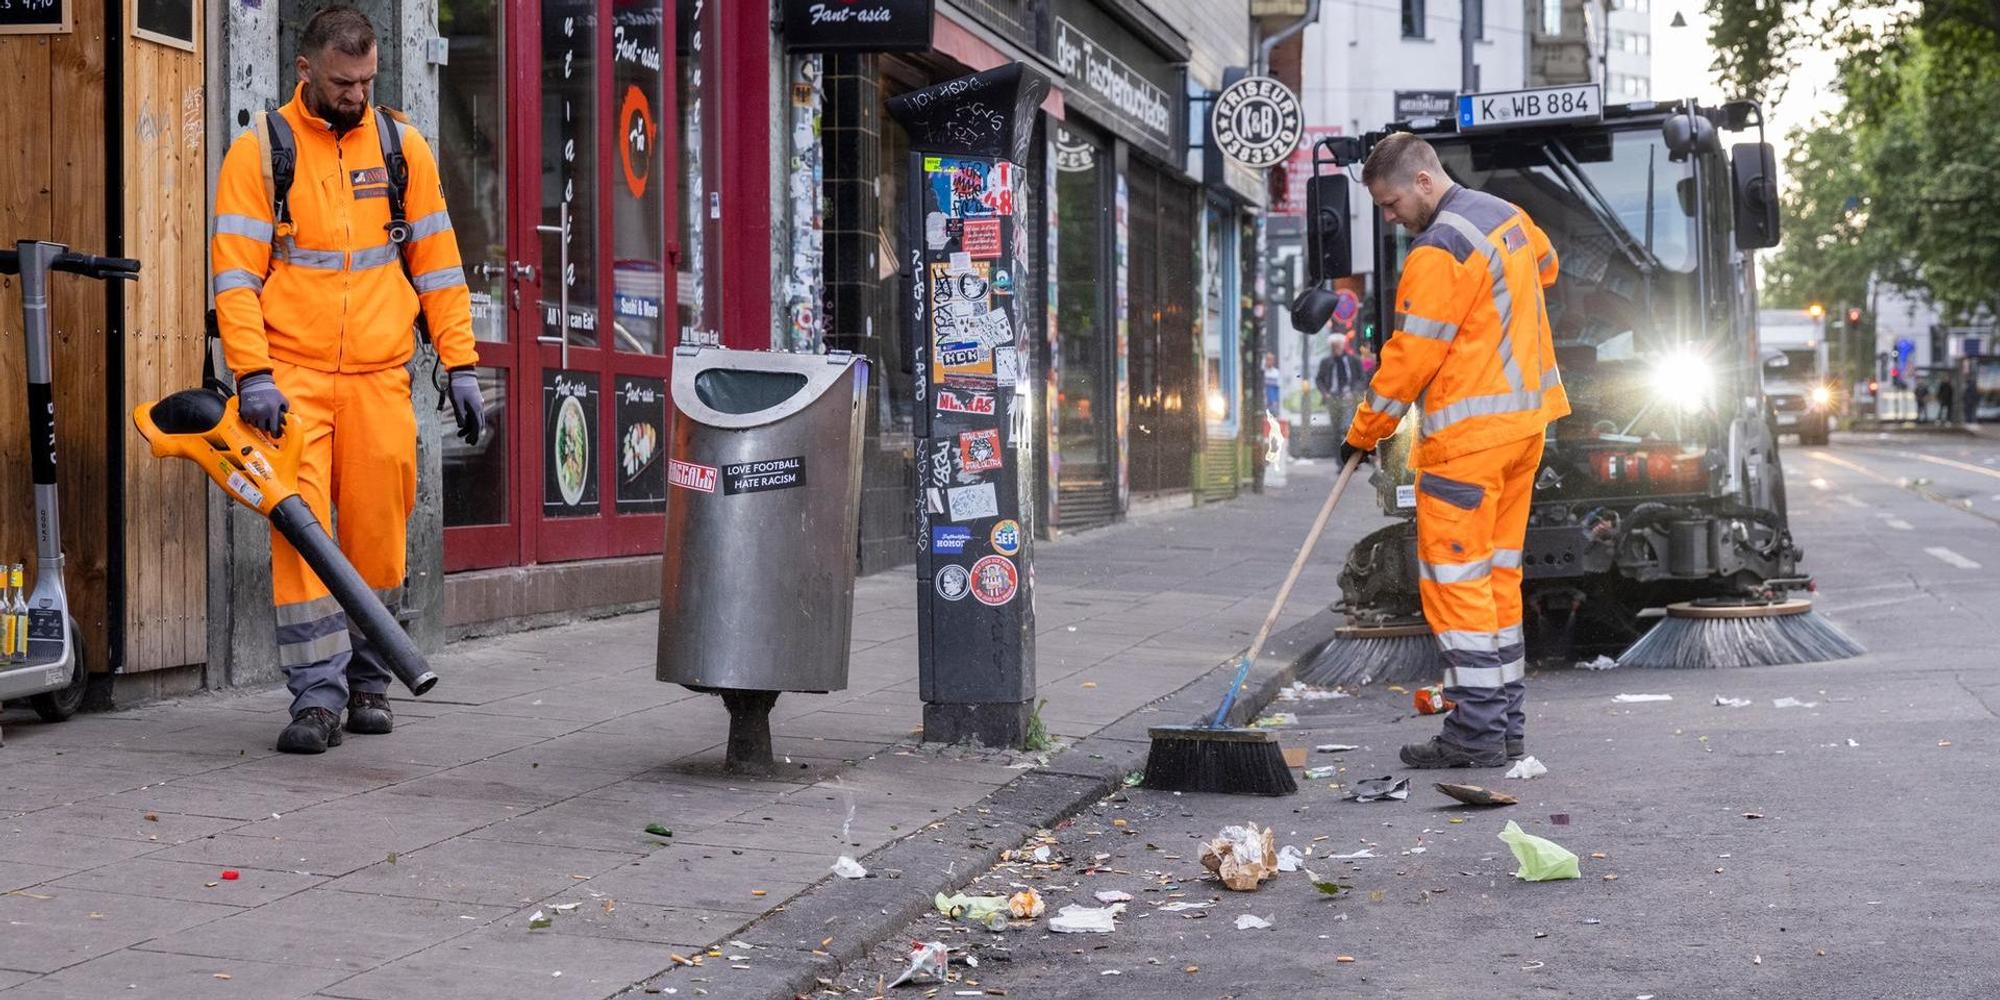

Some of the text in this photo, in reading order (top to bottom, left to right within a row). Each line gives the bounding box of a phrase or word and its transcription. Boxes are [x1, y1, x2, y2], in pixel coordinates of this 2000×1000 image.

[808, 3, 892, 25] Fant-asia
[614, 25, 661, 72] Fant-asia
[1082, 41, 1170, 137] Taschenbuchladen
[1219, 81, 1295, 117] FRISEUR
[1481, 99, 1496, 121] K
[1512, 96, 1541, 119] WB
[1547, 90, 1589, 115] 884
[1241, 105, 1273, 139] K&B
[1219, 130, 1295, 164] 9383320
[570, 315, 582, 329] can
[582, 311, 595, 331] Eat
[620, 297, 638, 315] Sushi
[644, 303, 658, 318] More
[726, 458, 800, 476] LOVE FOOTBALL
[734, 473, 797, 490] HATE RACISM
